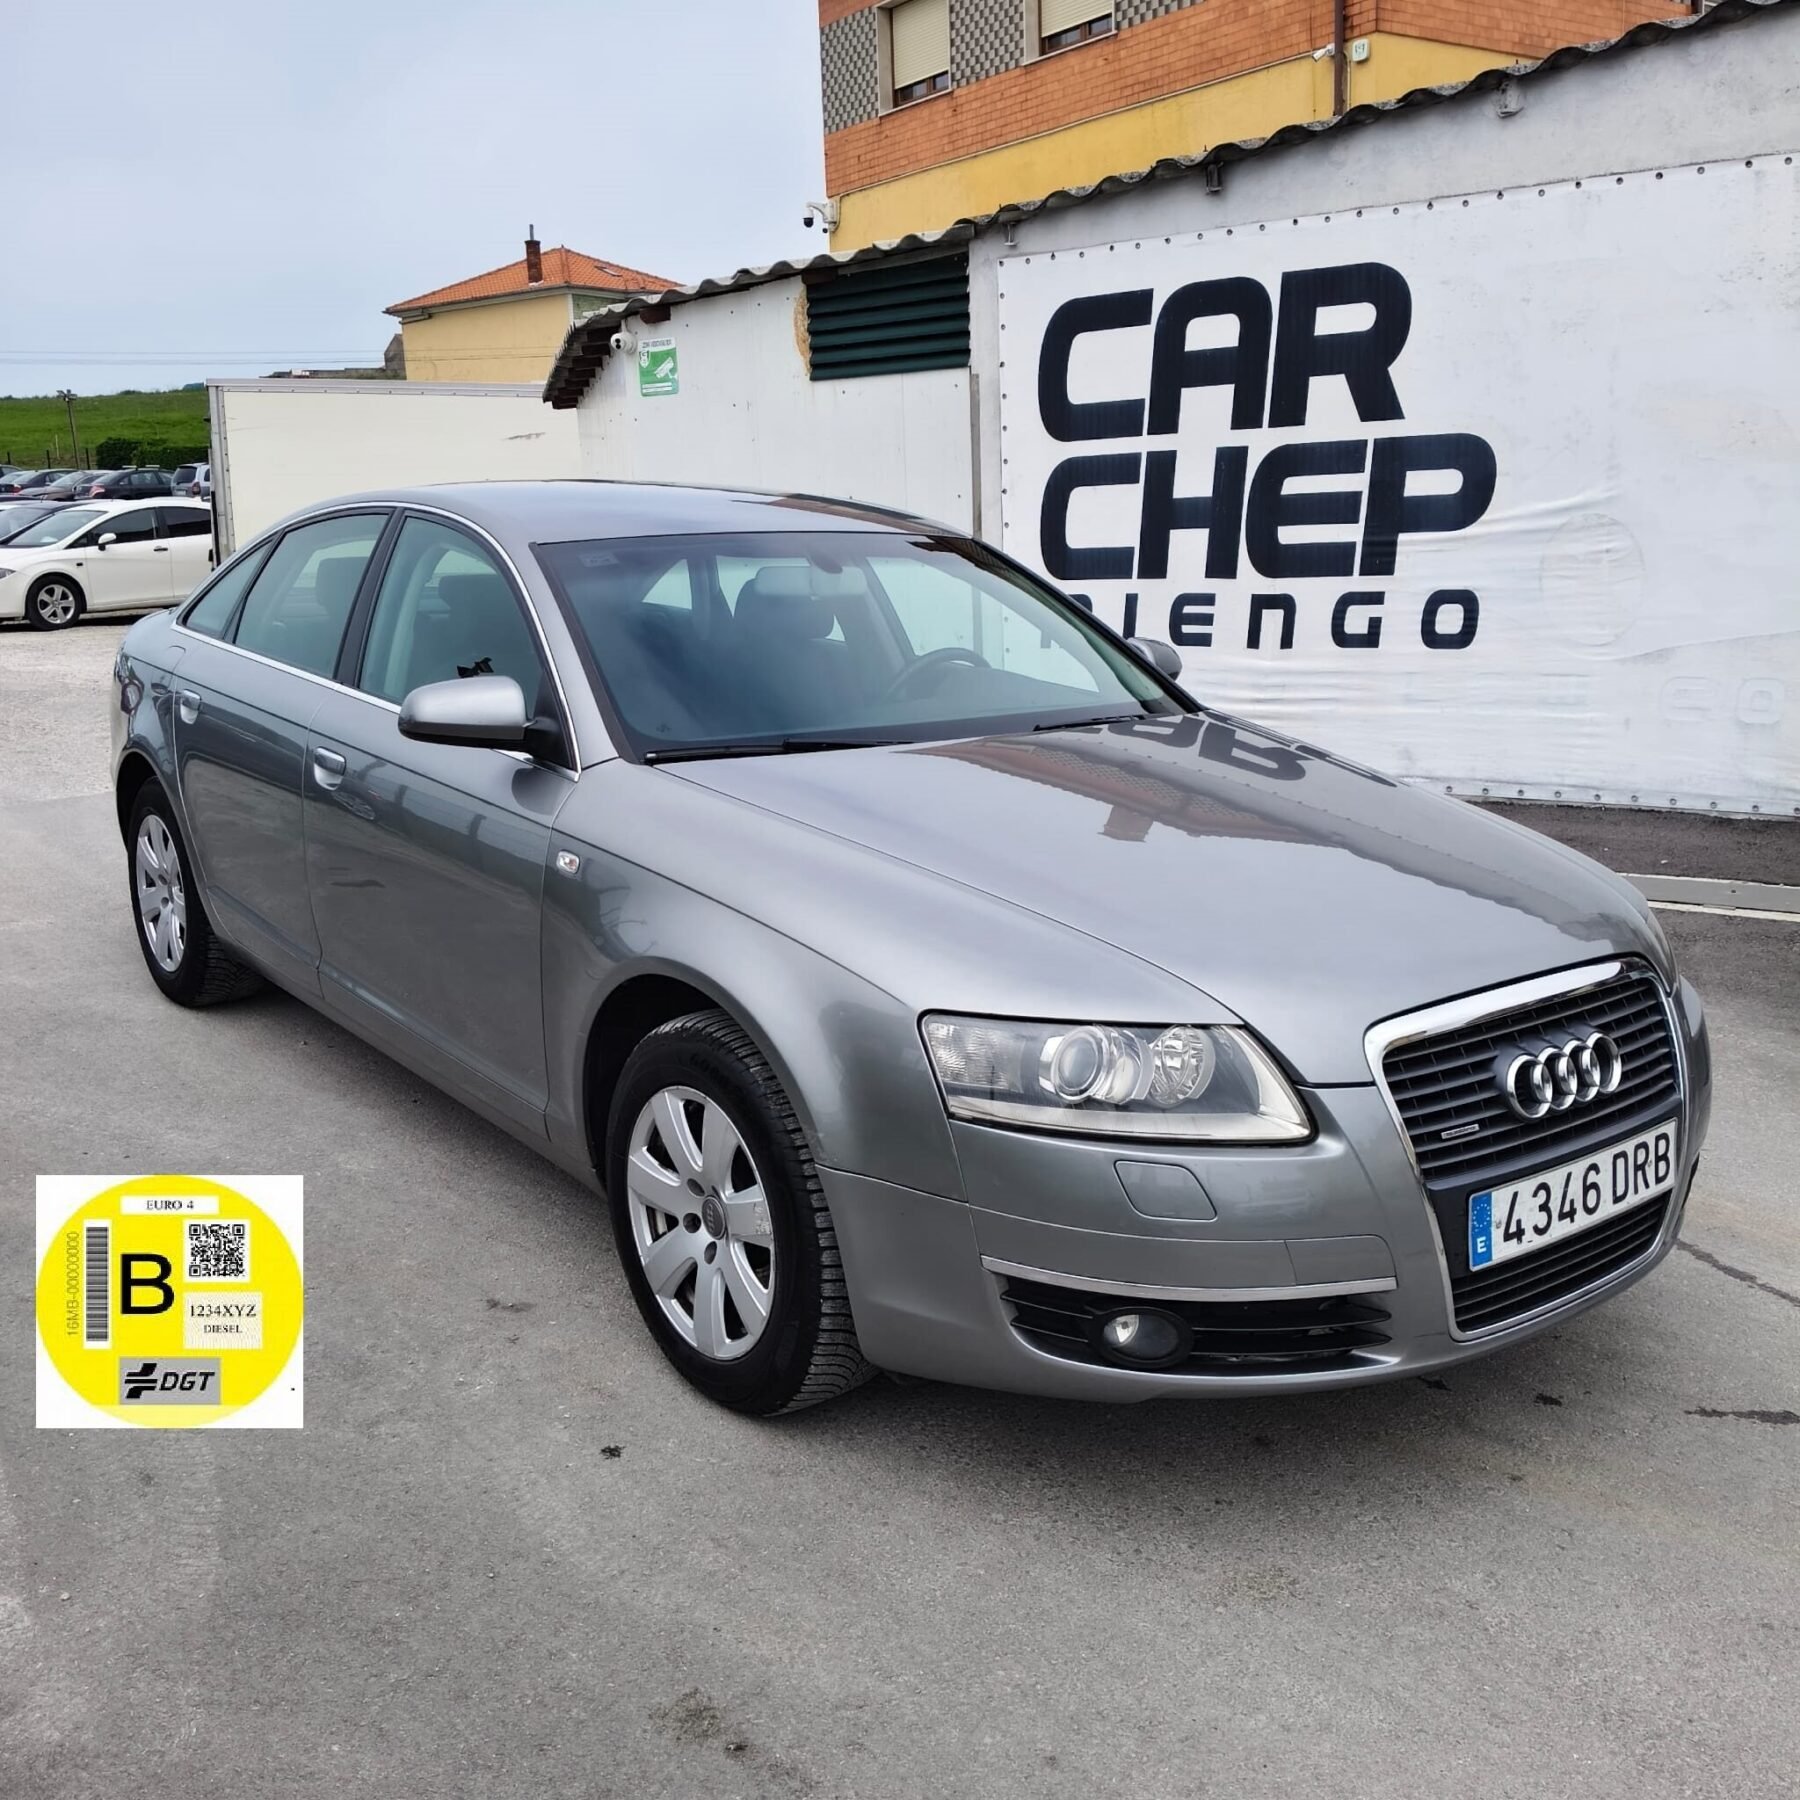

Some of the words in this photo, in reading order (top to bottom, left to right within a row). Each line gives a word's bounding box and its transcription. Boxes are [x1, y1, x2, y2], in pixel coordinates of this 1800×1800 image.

[1038, 262, 1412, 442] CAR
[1040, 432, 1497, 580] CHEP
[1066, 589, 1480, 650] IENGO
[1503, 1162, 1601, 1244] 4346
[1611, 1132, 1671, 1205] DRB
[1476, 1236, 1487, 1254] E
